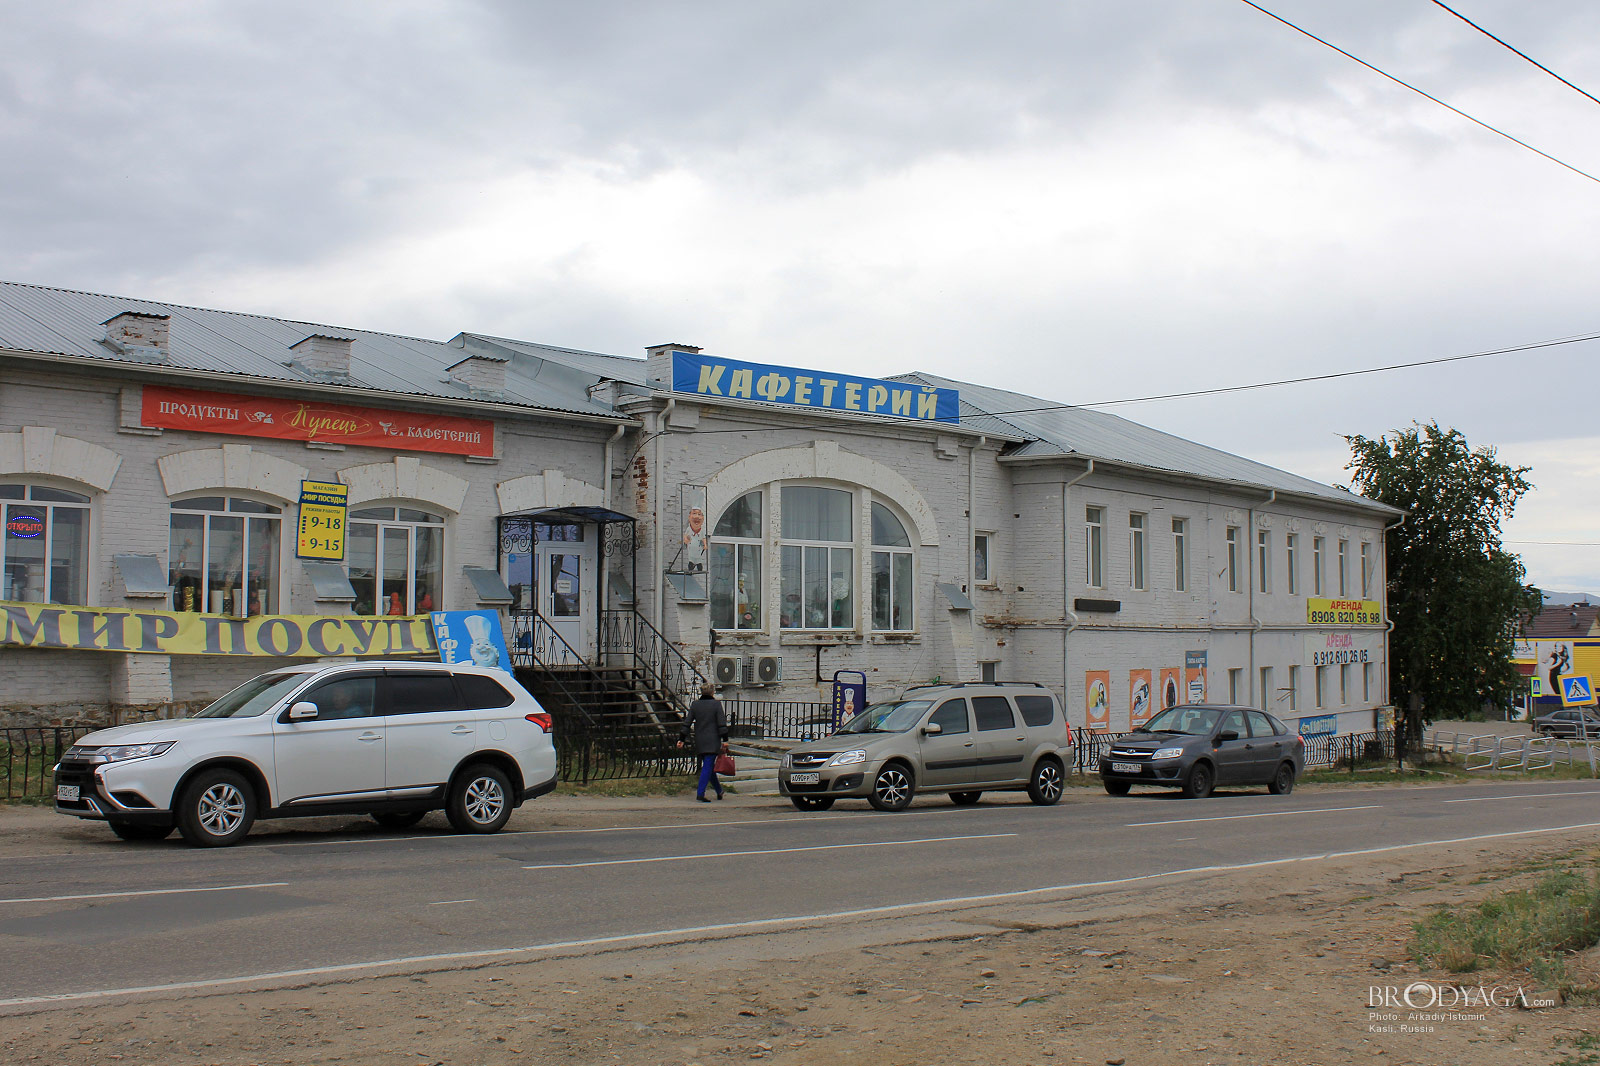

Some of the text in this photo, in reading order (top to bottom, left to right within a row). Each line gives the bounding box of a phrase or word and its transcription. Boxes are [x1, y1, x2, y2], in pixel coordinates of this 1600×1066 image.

[697, 364, 938, 420] КАФЕТЕРИЙ
[159, 401, 239, 421] ПРОДУКТЫ
[407, 426, 481, 444] КАФЕТЕРИЙ
[6, 522, 44, 532] ОТКРЫТО
[311, 516, 341, 530] 9-18
[309, 537, 340, 551] 9-15
[1330, 601, 1363, 612] АРЕНДА
[1311, 611, 1380, 623] 8908 820 58 98
[0, 605, 179, 653] МИР
[433, 613, 459, 664] КАФЕ
[1326, 632, 1353, 649] АРЕНДА
[1313, 649, 1368, 666] 8 912 610 26 05
